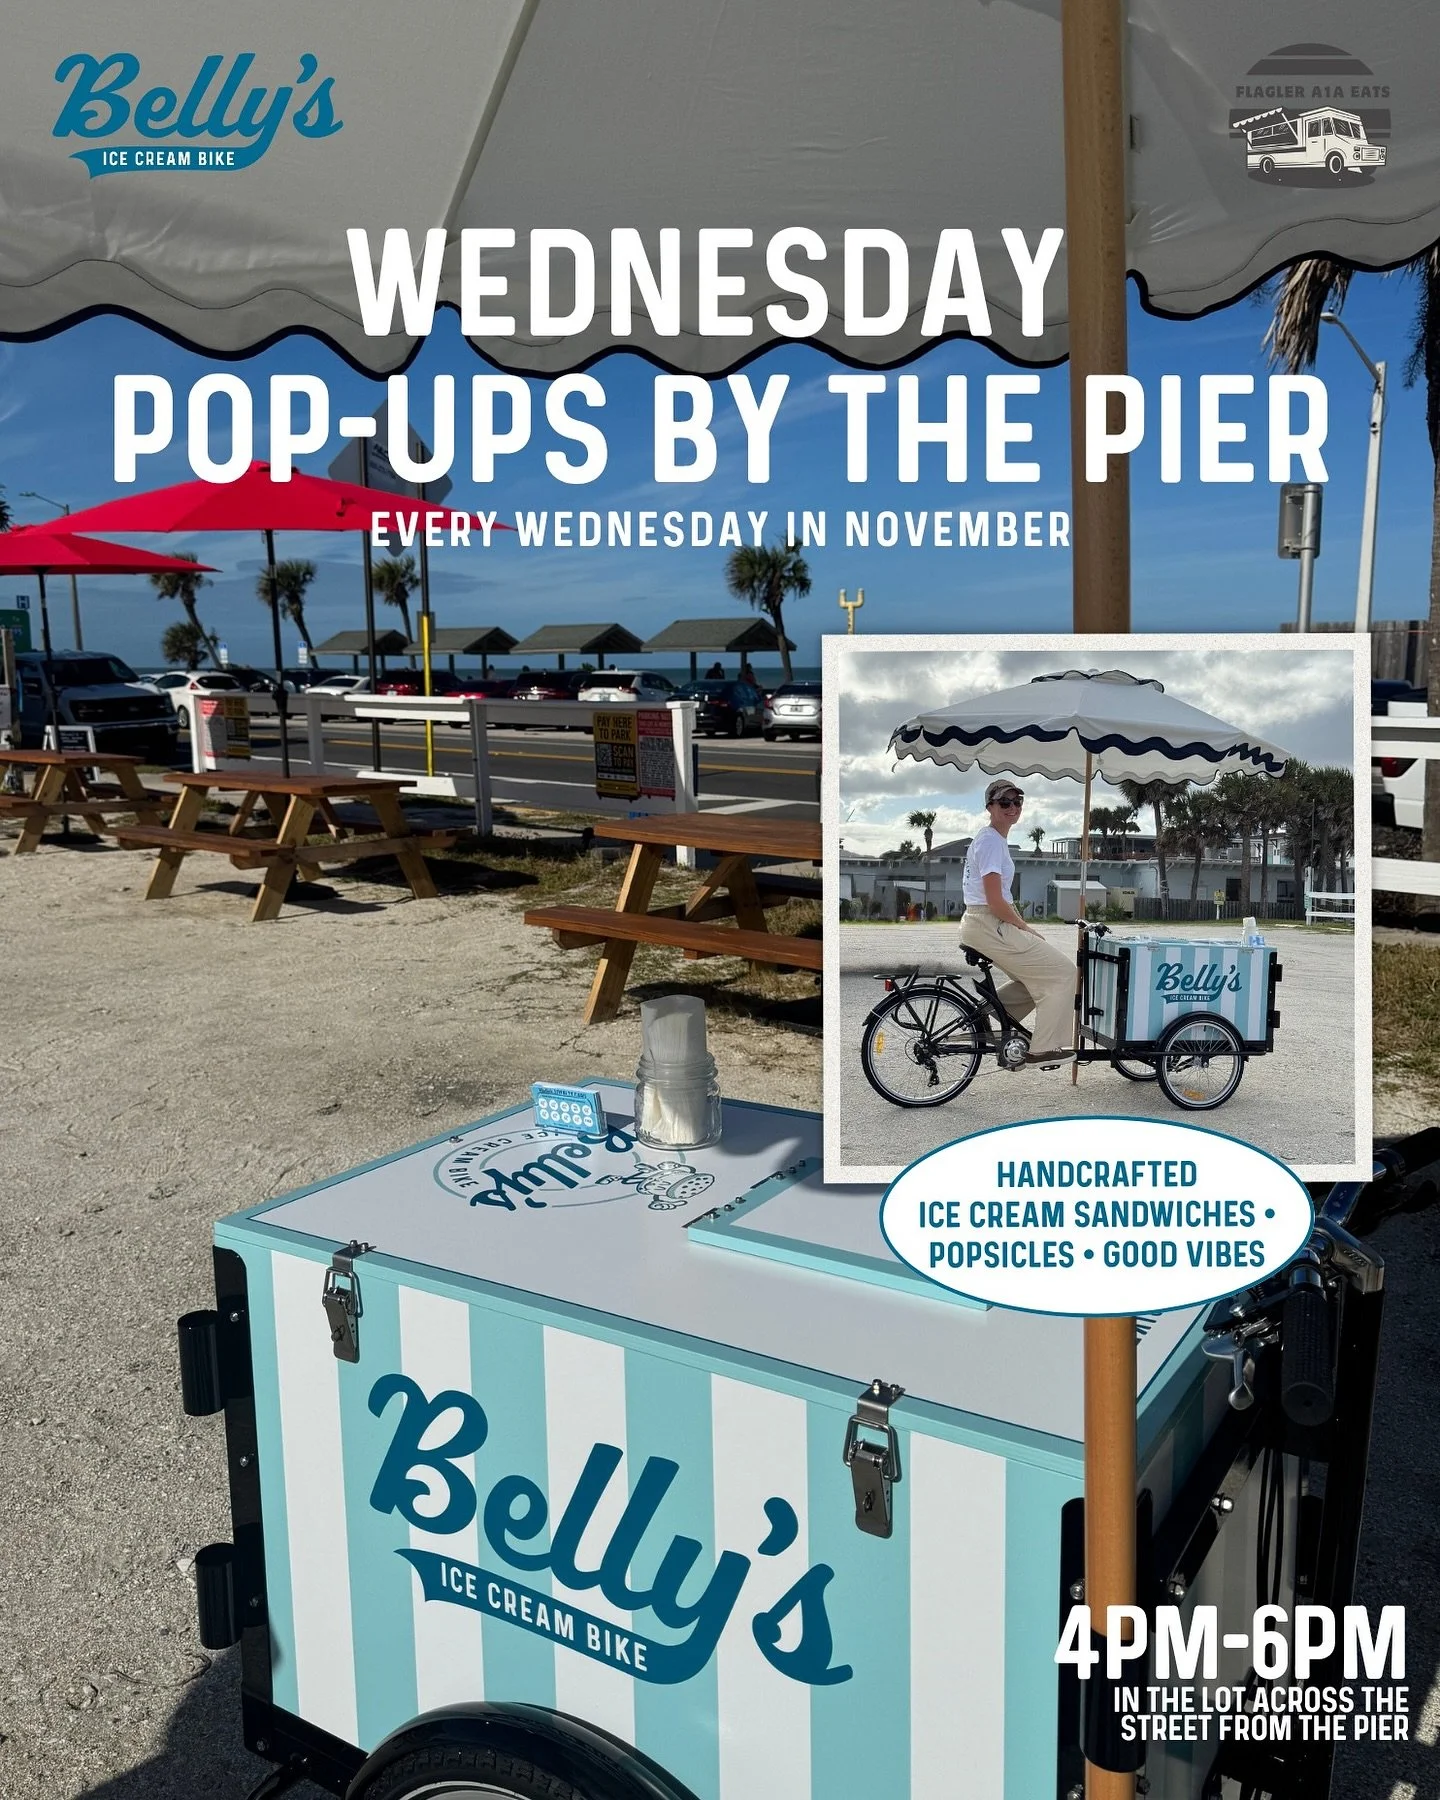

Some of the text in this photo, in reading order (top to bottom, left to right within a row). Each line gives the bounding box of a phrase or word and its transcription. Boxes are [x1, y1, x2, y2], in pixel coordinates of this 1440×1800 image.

[596, 715, 610, 727] PAY
[613, 716, 632, 729] HERE
[599, 728, 609, 740] TO
[611, 729, 631, 741] PARK
[613, 745, 634, 758] SCAN
[1156, 963, 1242, 993] Belly's
[452, 1137, 513, 1164] CREAM
[448, 1167, 480, 1189] BIKE
[368, 1374, 853, 1685] Belly's
[441, 1562, 648, 1671] ICE CREAM BIKE
